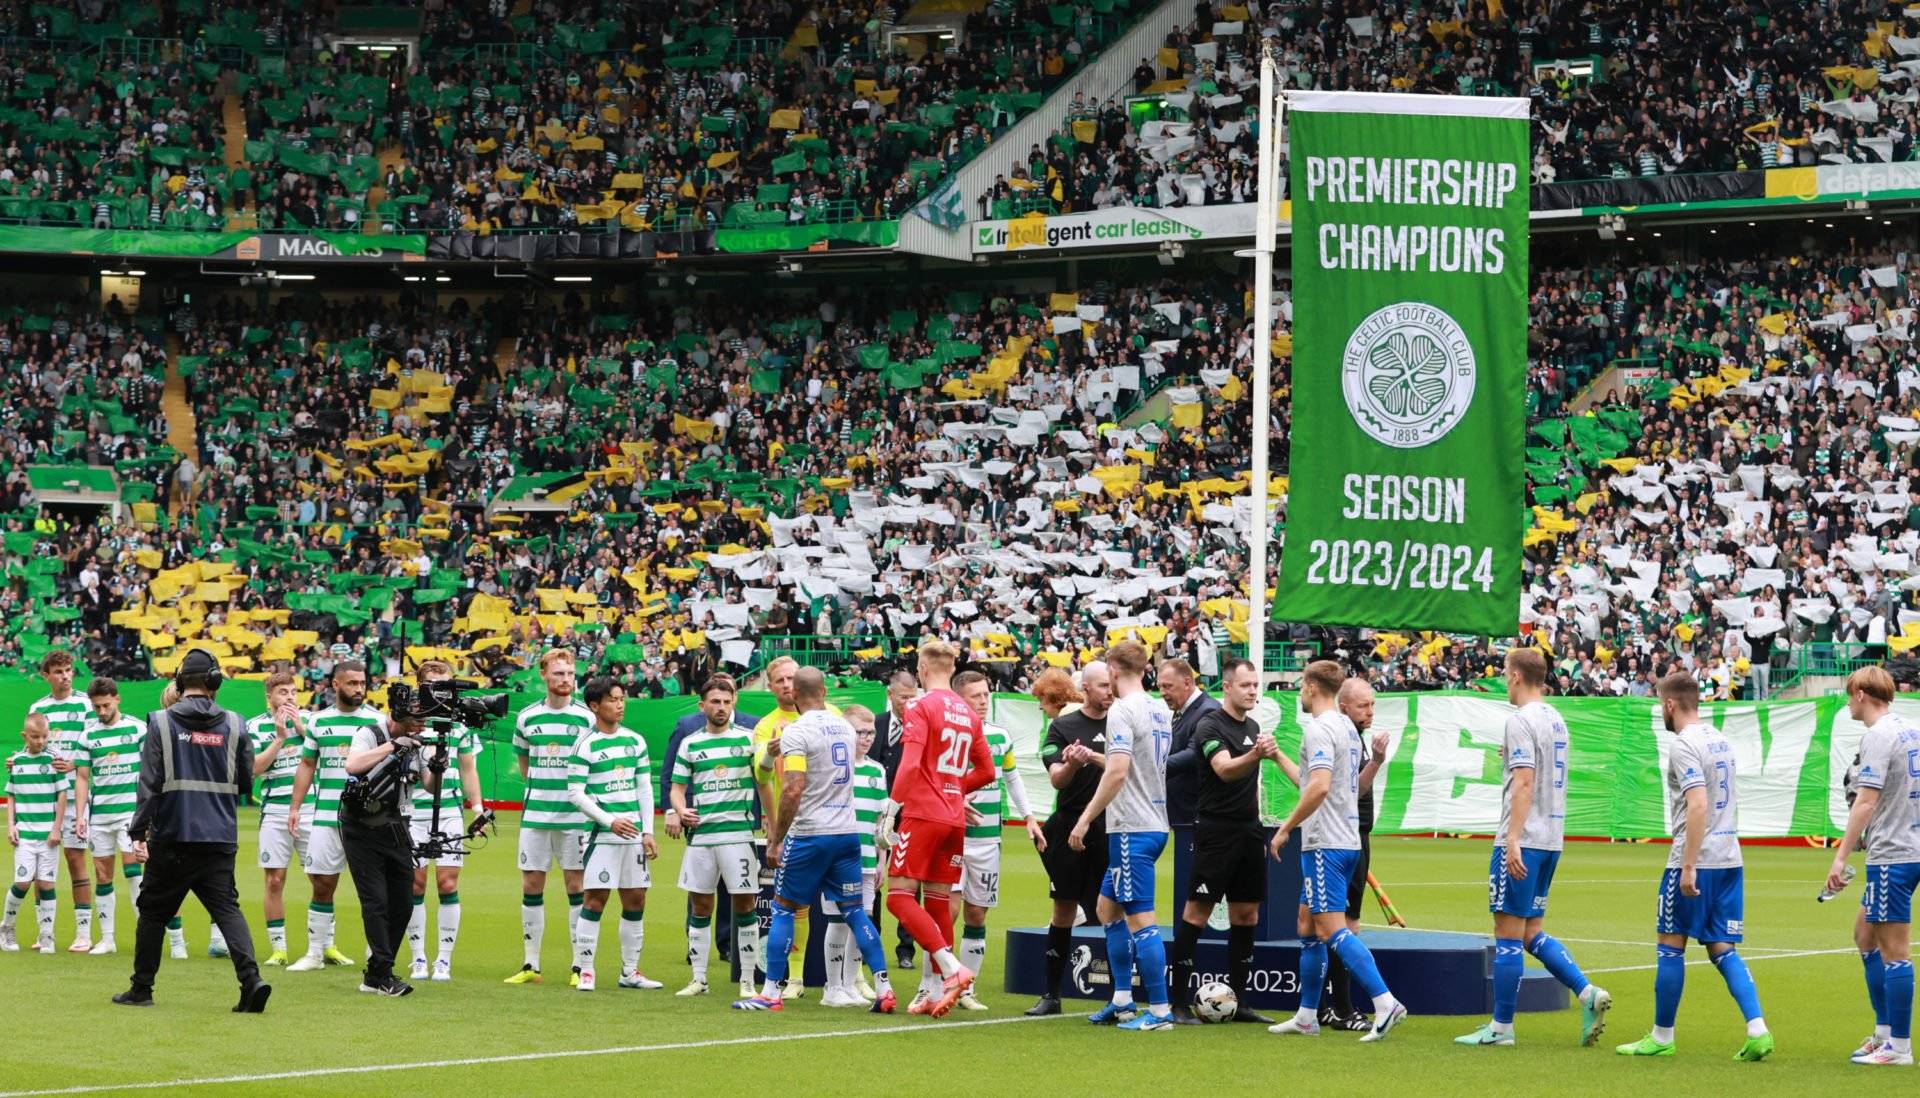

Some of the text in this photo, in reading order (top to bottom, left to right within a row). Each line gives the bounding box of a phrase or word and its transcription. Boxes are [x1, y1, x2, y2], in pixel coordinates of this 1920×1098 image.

[1306, 156, 1517, 208] PREMIERSHIP
[1095, 223, 1128, 239] car
[1319, 223, 1505, 274] CHAMPIONS
[1345, 306, 1472, 377] THE CELTIC FOOTBALL CLUB
[1393, 428, 1419, 441] 1888
[1343, 473, 1466, 524] SEASON
[1306, 538, 1495, 593] 2023/2024
[178, 733, 192, 743] sky
[936, 728, 973, 778] 20
[1152, 729, 1171, 774] 17
[831, 742, 851, 785] 9
[1554, 741, 1567, 788] 5
[702, 779, 741, 793] dafabet
[637, 854, 646, 872] 4
[740, 858, 750, 878] 3
[981, 872, 999, 892] 42
